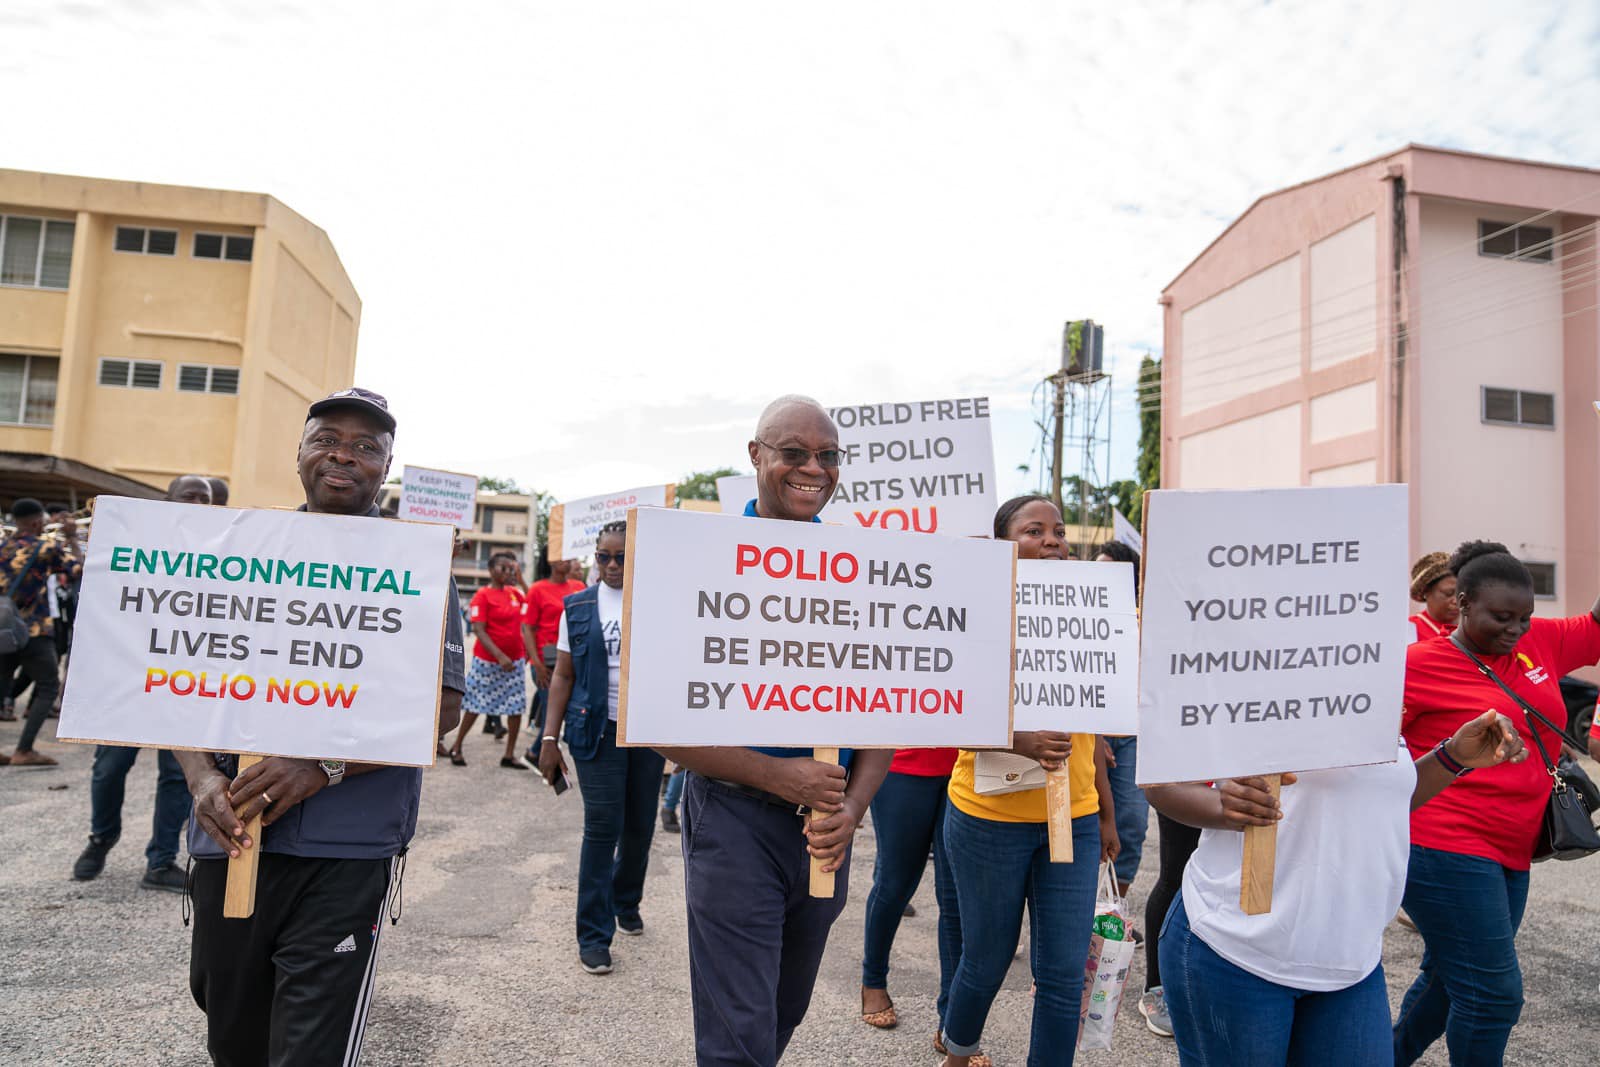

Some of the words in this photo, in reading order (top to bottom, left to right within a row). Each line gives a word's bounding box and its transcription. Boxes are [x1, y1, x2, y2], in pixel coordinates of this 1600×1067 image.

[829, 403, 912, 428] ORLD
[920, 397, 990, 422] FREE
[845, 444, 861, 465] F
[869, 437, 954, 463] POLIO
[404, 484, 472, 501] ENVIRONMENT
[418, 475, 443, 485] KEEP
[444, 478, 462, 488] THE
[830, 478, 904, 505] ARTS
[909, 472, 985, 498] WITH
[409, 505, 439, 518] POLIO
[440, 511, 464, 521] NOW
[444, 500, 469, 511] STOP
[589, 501, 604, 512] NO
[606, 495, 637, 509] CHILD
[571, 511, 612, 528] SHOULD
[854, 506, 938, 534] YOU
[735, 543, 859, 584] POLIO
[868, 559, 933, 589] HAS
[1207, 540, 1360, 568] COMPLETE
[110, 546, 421, 596] ENVIRONMENTAL
[119, 586, 277, 624] HYGIENE
[286, 600, 402, 634] SAVES
[1016, 583, 1077, 607] ETHER
[1079, 585, 1109, 608] WE
[1184, 597, 1267, 622] YOUR
[1275, 591, 1379, 619] CHILD'S
[697, 590, 751, 620] NO
[759, 594, 860, 631] CURE;
[868, 601, 896, 629] IT
[902, 603, 966, 633] CAN
[1017, 615, 1053, 639] END
[1057, 616, 1110, 641] POLIO
[149, 628, 250, 661] LIVES
[289, 640, 363, 670] END
[703, 636, 749, 666] BE
[759, 639, 954, 673] PREVENTED
[1015, 648, 1067, 673] TARTS
[1070, 650, 1117, 674] WITH
[1169, 642, 1381, 675] IMMUNIZATION
[144, 667, 257, 701] POLIO
[266, 677, 360, 709] NOW
[687, 681, 736, 710] BY
[741, 683, 964, 715] VACCINATION
[1036, 683, 1075, 707] AND
[1079, 684, 1106, 709] ME
[1180, 702, 1220, 726] BY
[1224, 699, 1301, 723] YEAR
[1308, 693, 1372, 718] TWO
